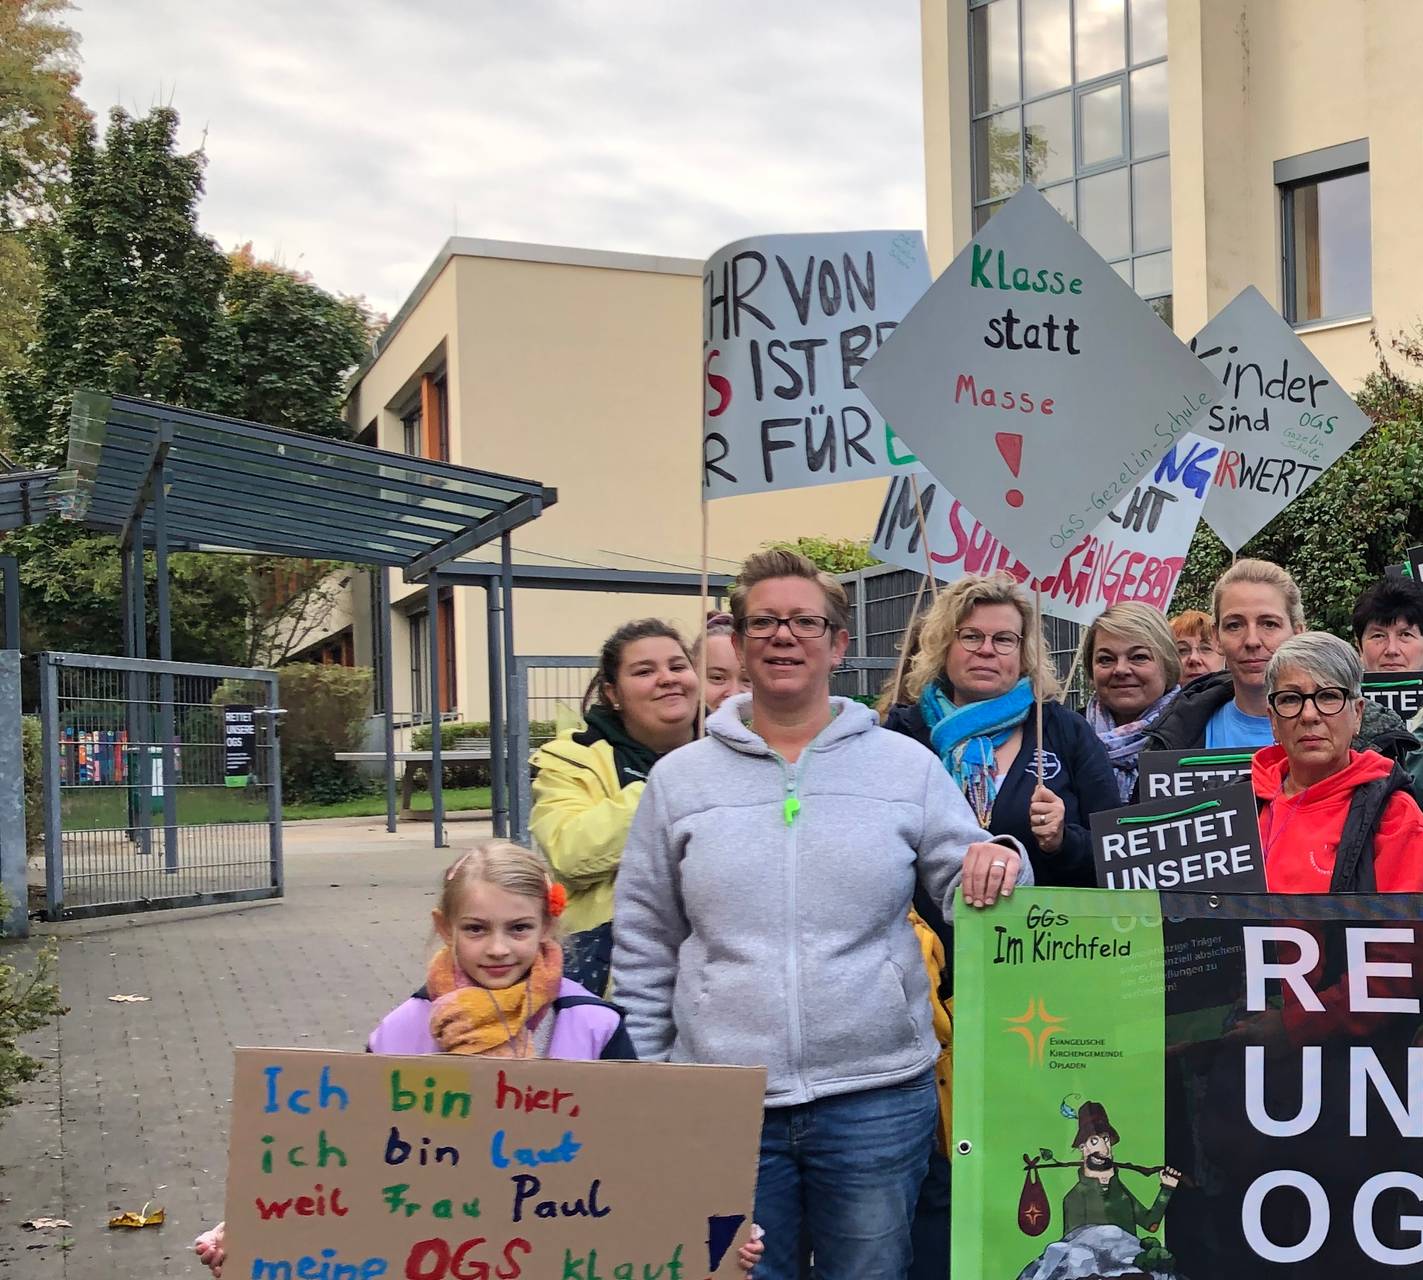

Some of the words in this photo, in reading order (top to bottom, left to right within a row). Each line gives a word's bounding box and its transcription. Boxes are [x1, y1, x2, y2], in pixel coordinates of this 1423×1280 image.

[970, 243, 1083, 295] Klasse
[703, 250, 776, 341] HR
[775, 250, 877, 327] VON
[983, 308, 1081, 355] statt
[750, 338, 829, 402] IST
[955, 374, 1055, 415] Masse
[761, 404, 877, 484] FÜR
[1300, 411, 1338, 434] OGS
[226, 737, 243, 747] OGS
[1102, 810, 1238, 862] RETTET
[1106, 844, 1254, 890] UNSERE
[993, 926, 1024, 965] Im
[1032, 929, 1131, 963] Kirchfeld
[263, 1065, 349, 1115] Ich
[390, 1069, 472, 1119] bin
[496, 1070, 581, 1118] hier,
[260, 1129, 348, 1174] ich
[384, 1126, 460, 1167] bin
[491, 1129, 584, 1169] laut
[254, 1184, 349, 1221] weil
[381, 1183, 481, 1218] Frau
[510, 1174, 612, 1223] Paul
[250, 1248, 388, 1280] meine
[404, 1236, 532, 1280] OGS
